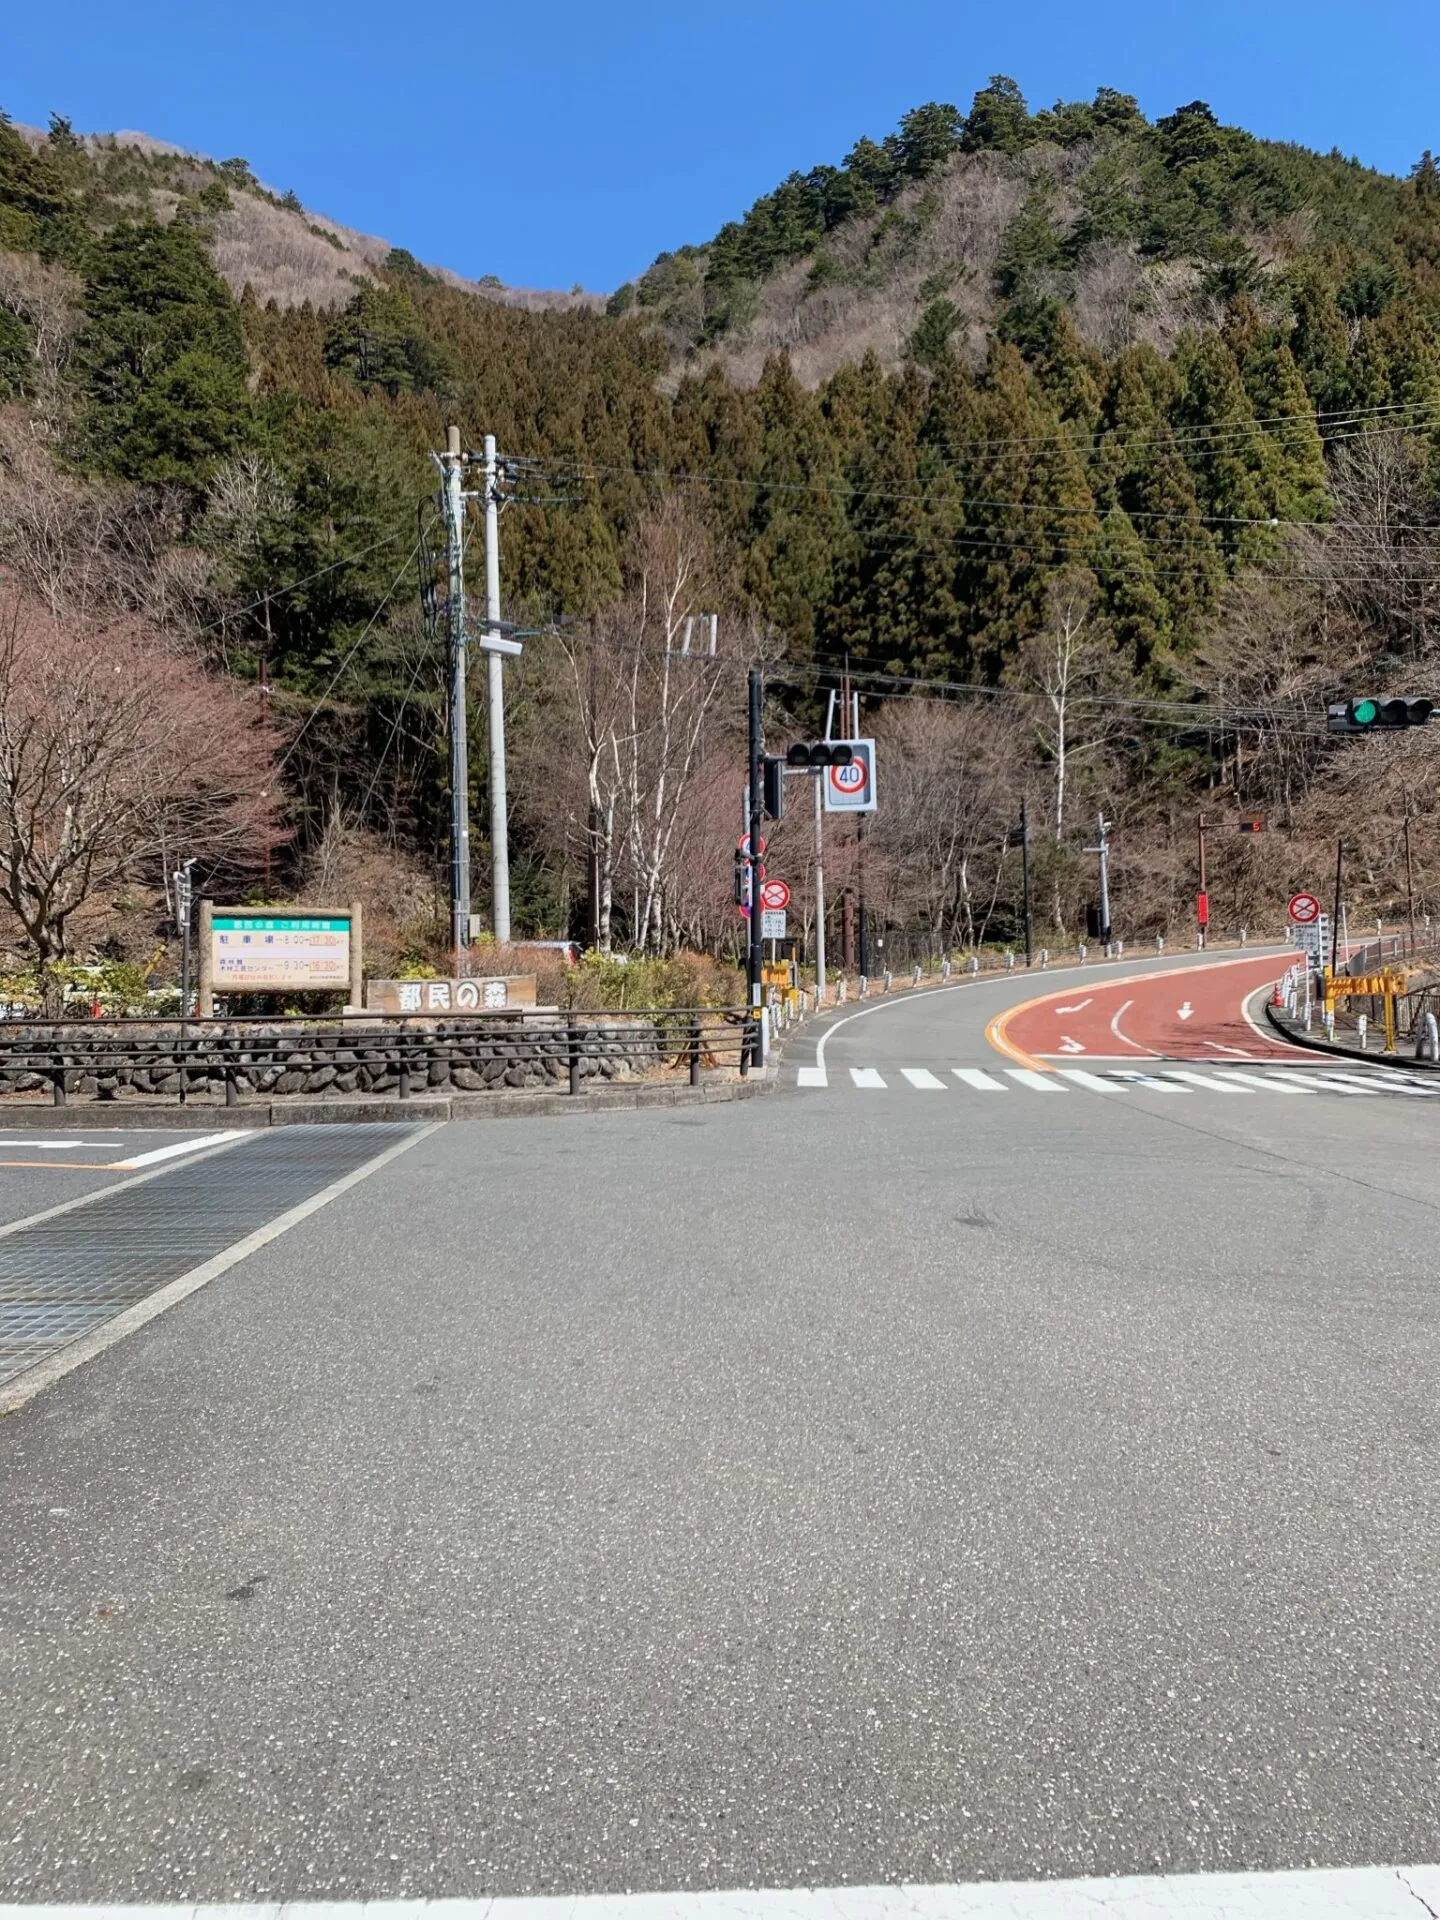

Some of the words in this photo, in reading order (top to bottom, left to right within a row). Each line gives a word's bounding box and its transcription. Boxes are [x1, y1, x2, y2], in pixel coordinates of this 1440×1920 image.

[839, 766, 860, 783] 40
[399, 981, 507, 1011] 都民の森
